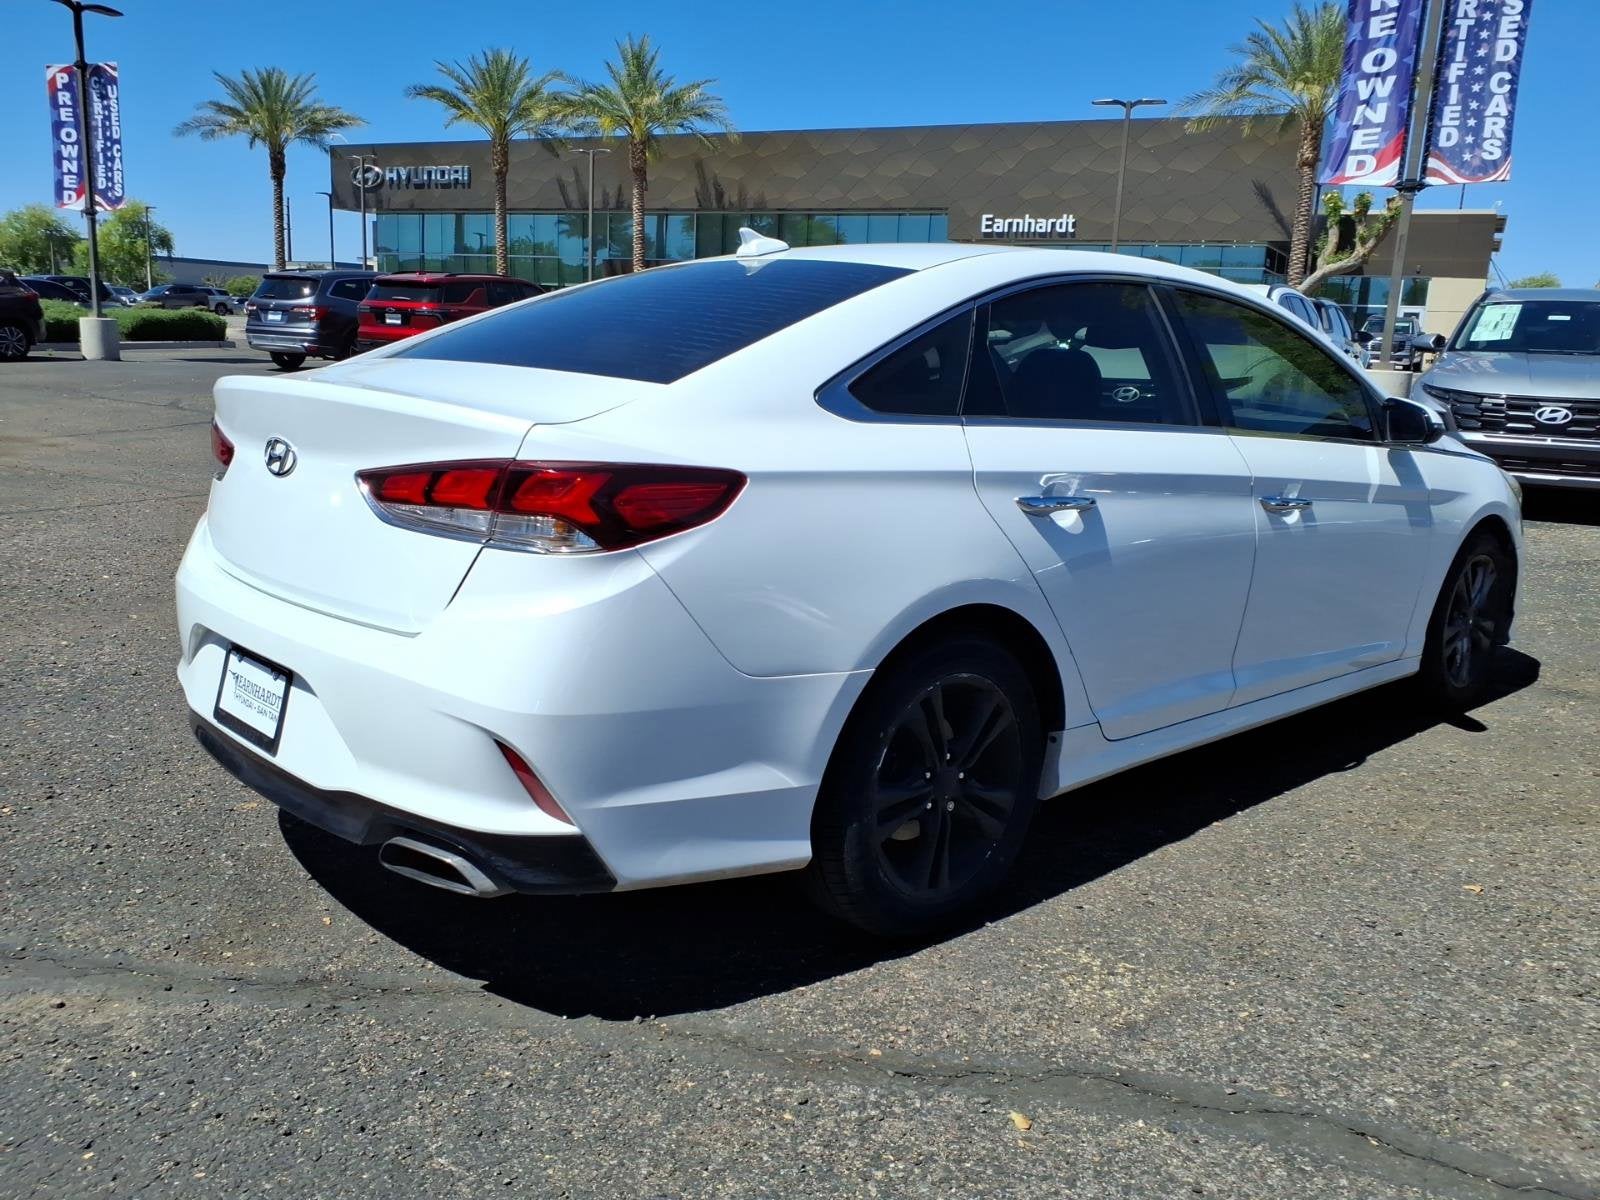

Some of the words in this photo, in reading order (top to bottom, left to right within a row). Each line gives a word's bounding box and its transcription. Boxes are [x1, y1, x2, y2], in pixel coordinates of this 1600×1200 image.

[55, 72, 75, 122] PRE
[107, 85, 121, 140] USED
[1345, 48, 1397, 177] OWNED
[1481, 71, 1512, 160] CARS
[91, 77, 106, 190] CERTIFIED
[60, 127, 79, 204] OWNED
[112, 144, 123, 197] CARS
[385, 165, 471, 185] HYUNDAI
[981, 213, 1076, 233] Earnhardt
